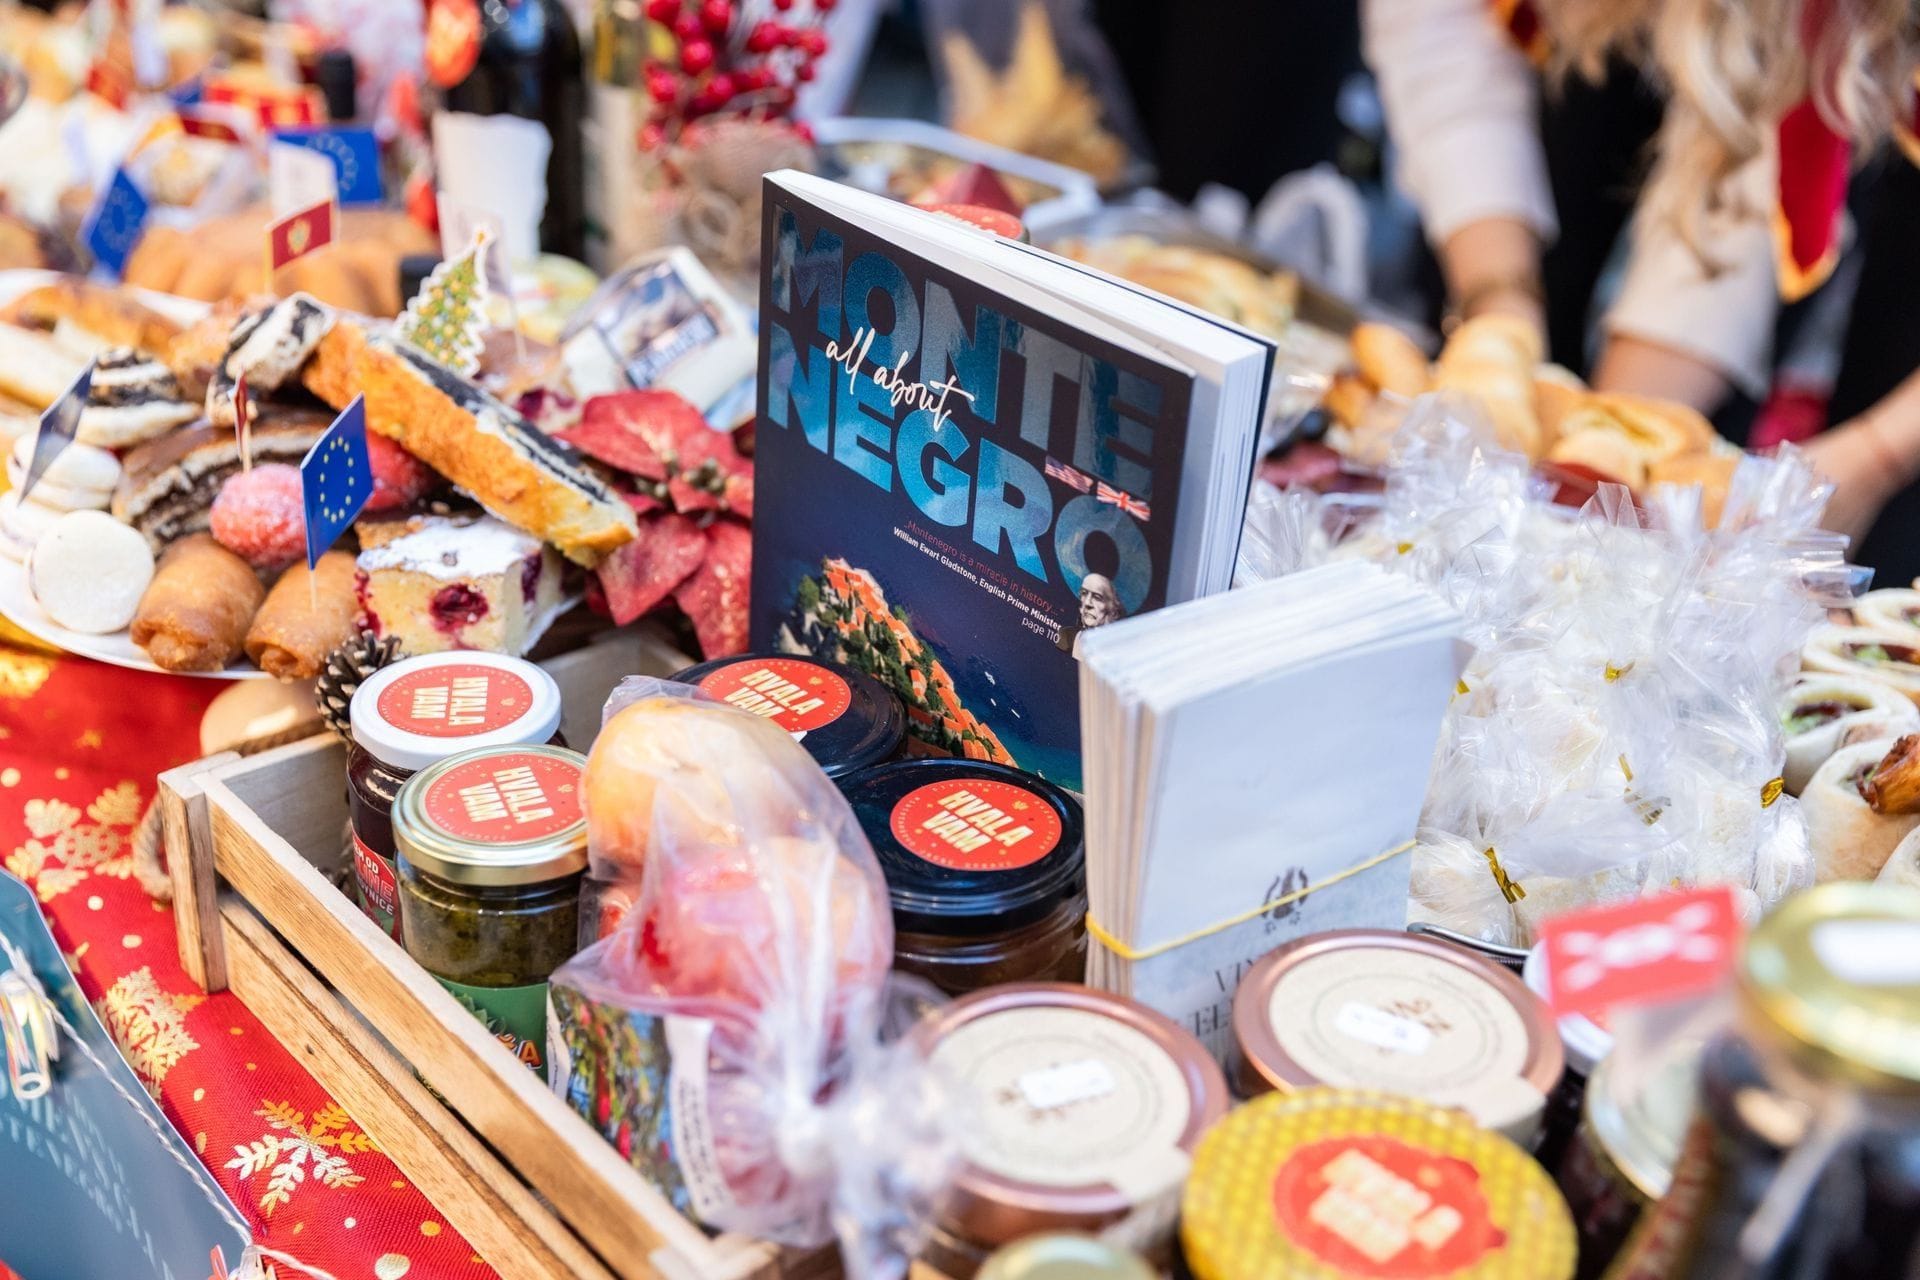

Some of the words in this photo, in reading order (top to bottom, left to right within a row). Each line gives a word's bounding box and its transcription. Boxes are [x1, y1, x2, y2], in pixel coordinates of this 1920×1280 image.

[771, 204, 1163, 499] MONTE
[825, 326, 876, 395] all
[873, 350, 975, 432] about
[767, 322, 1153, 617] NEGRO
[893, 526, 919, 548] William
[919, 542, 940, 561] Ewart
[940, 555, 978, 584] Gladstone,
[979, 578, 1007, 600] English
[1006, 594, 1030, 613] Prime
[1030, 607, 1062, 631] Minister
[976, 561, 1009, 587] miracle
[1010, 579, 1019, 593] in
[1021, 617, 1045, 636] page
[1046, 628, 1060, 644] 110
[411, 686, 449, 719] VAM
[448, 676, 489, 726] HVALA
[739, 668, 825, 715] HVALA
[458, 782, 509, 823] VAM
[492, 765, 554, 824] HVALA
[937, 789, 1034, 847] HVALA
[921, 810, 992, 853] VAM
[365, 857, 379, 874] OD
